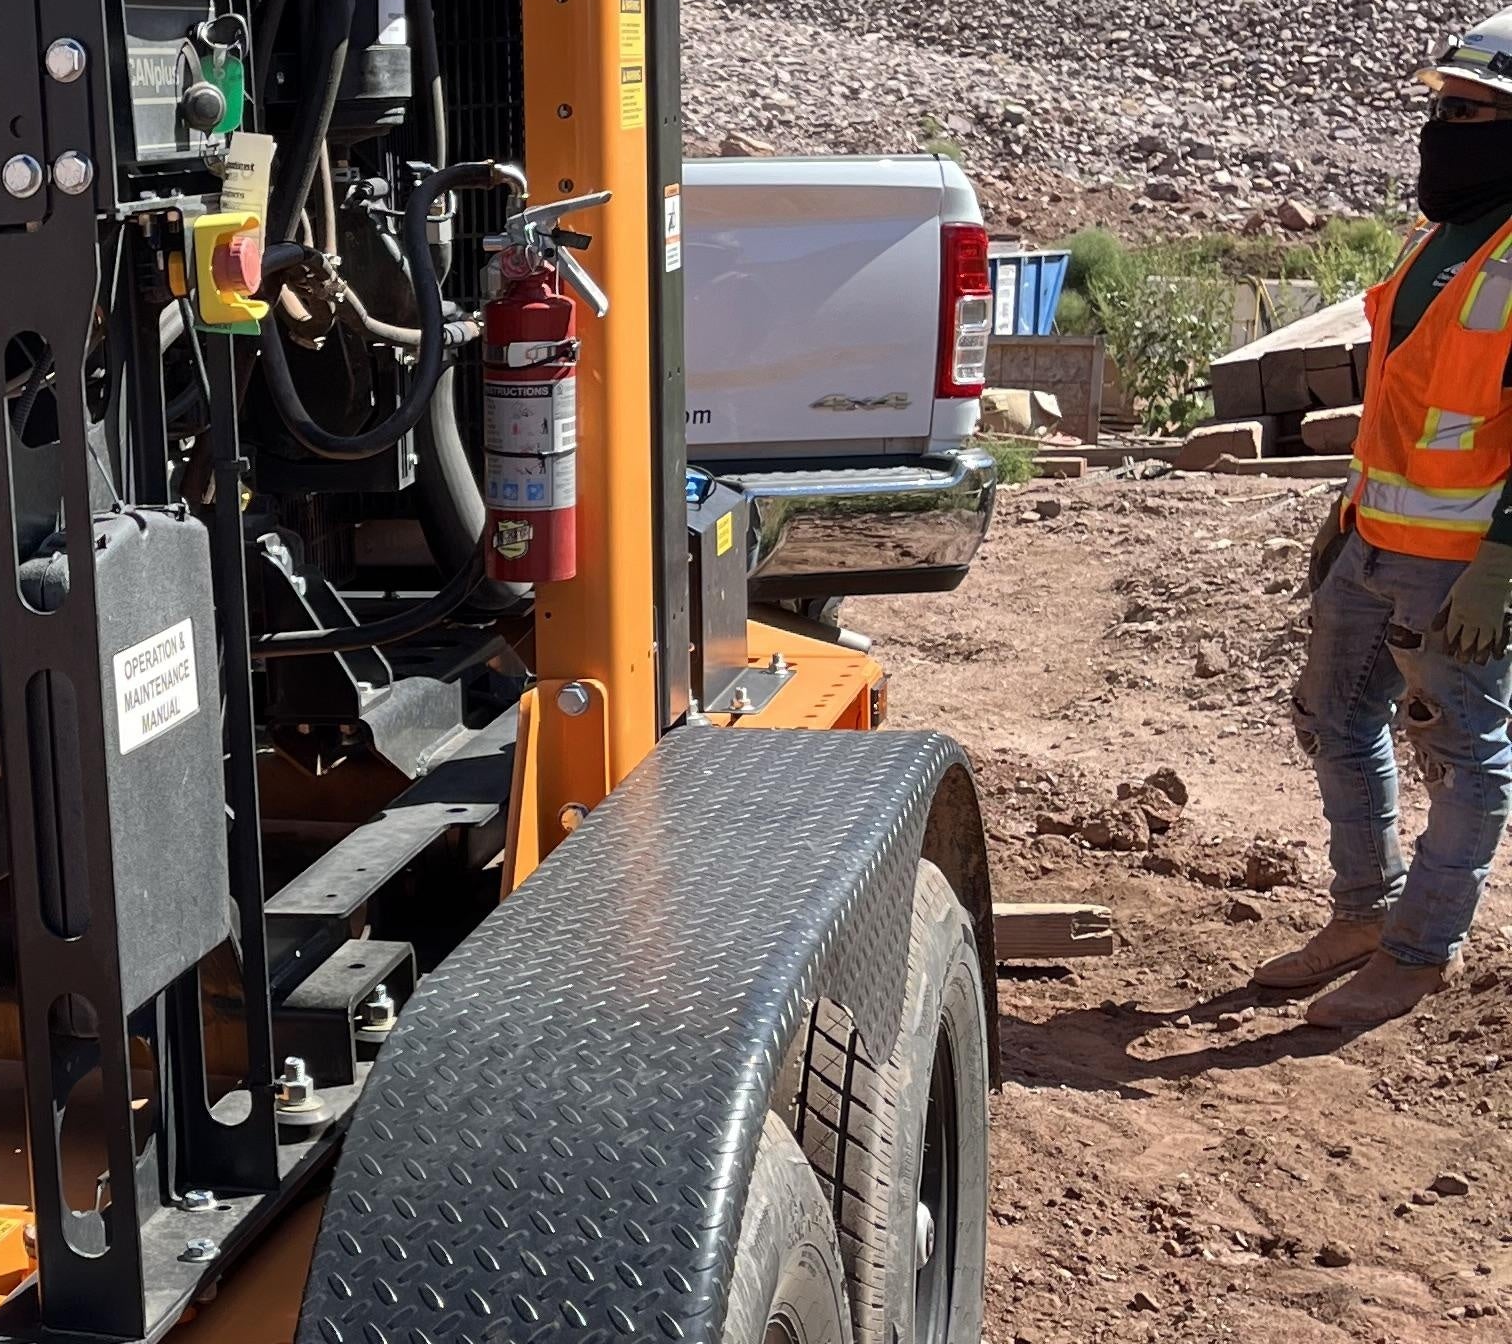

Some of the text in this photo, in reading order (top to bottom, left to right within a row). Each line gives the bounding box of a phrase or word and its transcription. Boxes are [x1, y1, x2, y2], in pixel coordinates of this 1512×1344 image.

[486, 385, 549, 397] STRUCTIONS
[124, 631, 186, 680] OPERATION &
[124, 658, 190, 713] MAINTENANCE
[142, 695, 181, 735] MANUAL
